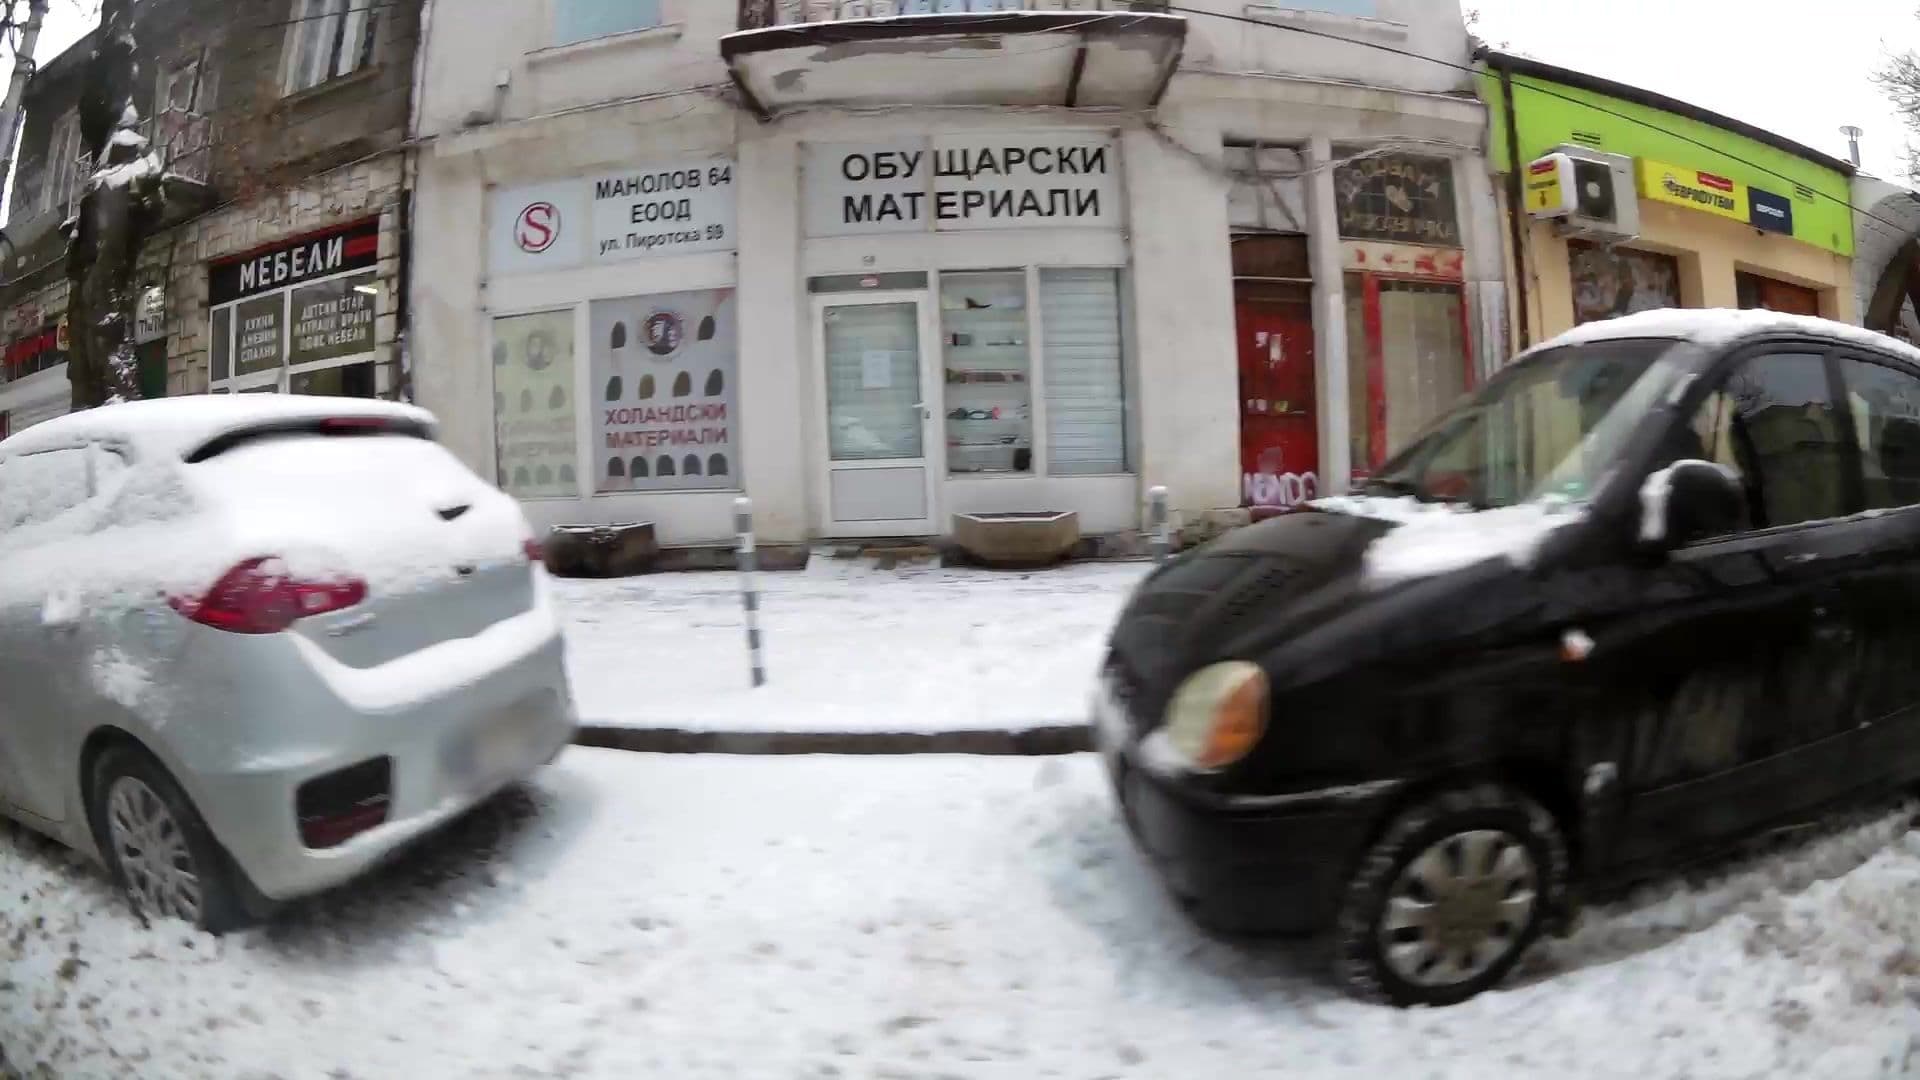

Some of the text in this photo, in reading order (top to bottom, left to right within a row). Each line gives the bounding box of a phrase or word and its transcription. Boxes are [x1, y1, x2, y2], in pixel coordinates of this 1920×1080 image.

[842, 147, 1107, 181] ОБУЩАРСКИ
[596, 165, 731, 200] МАНОЛОВ 64
[631, 199, 691, 224] ЕООД
[843, 188, 1100, 223] МАТЕРИАЛИ
[521, 206, 552, 248] S
[626, 226, 701, 251] Пиротска
[240, 236, 343, 292] МЕБЕЛИ
[605, 403, 727, 426] ХОЛАНДСКИ
[606, 428, 728, 448] МАТЕРИАЛИ
